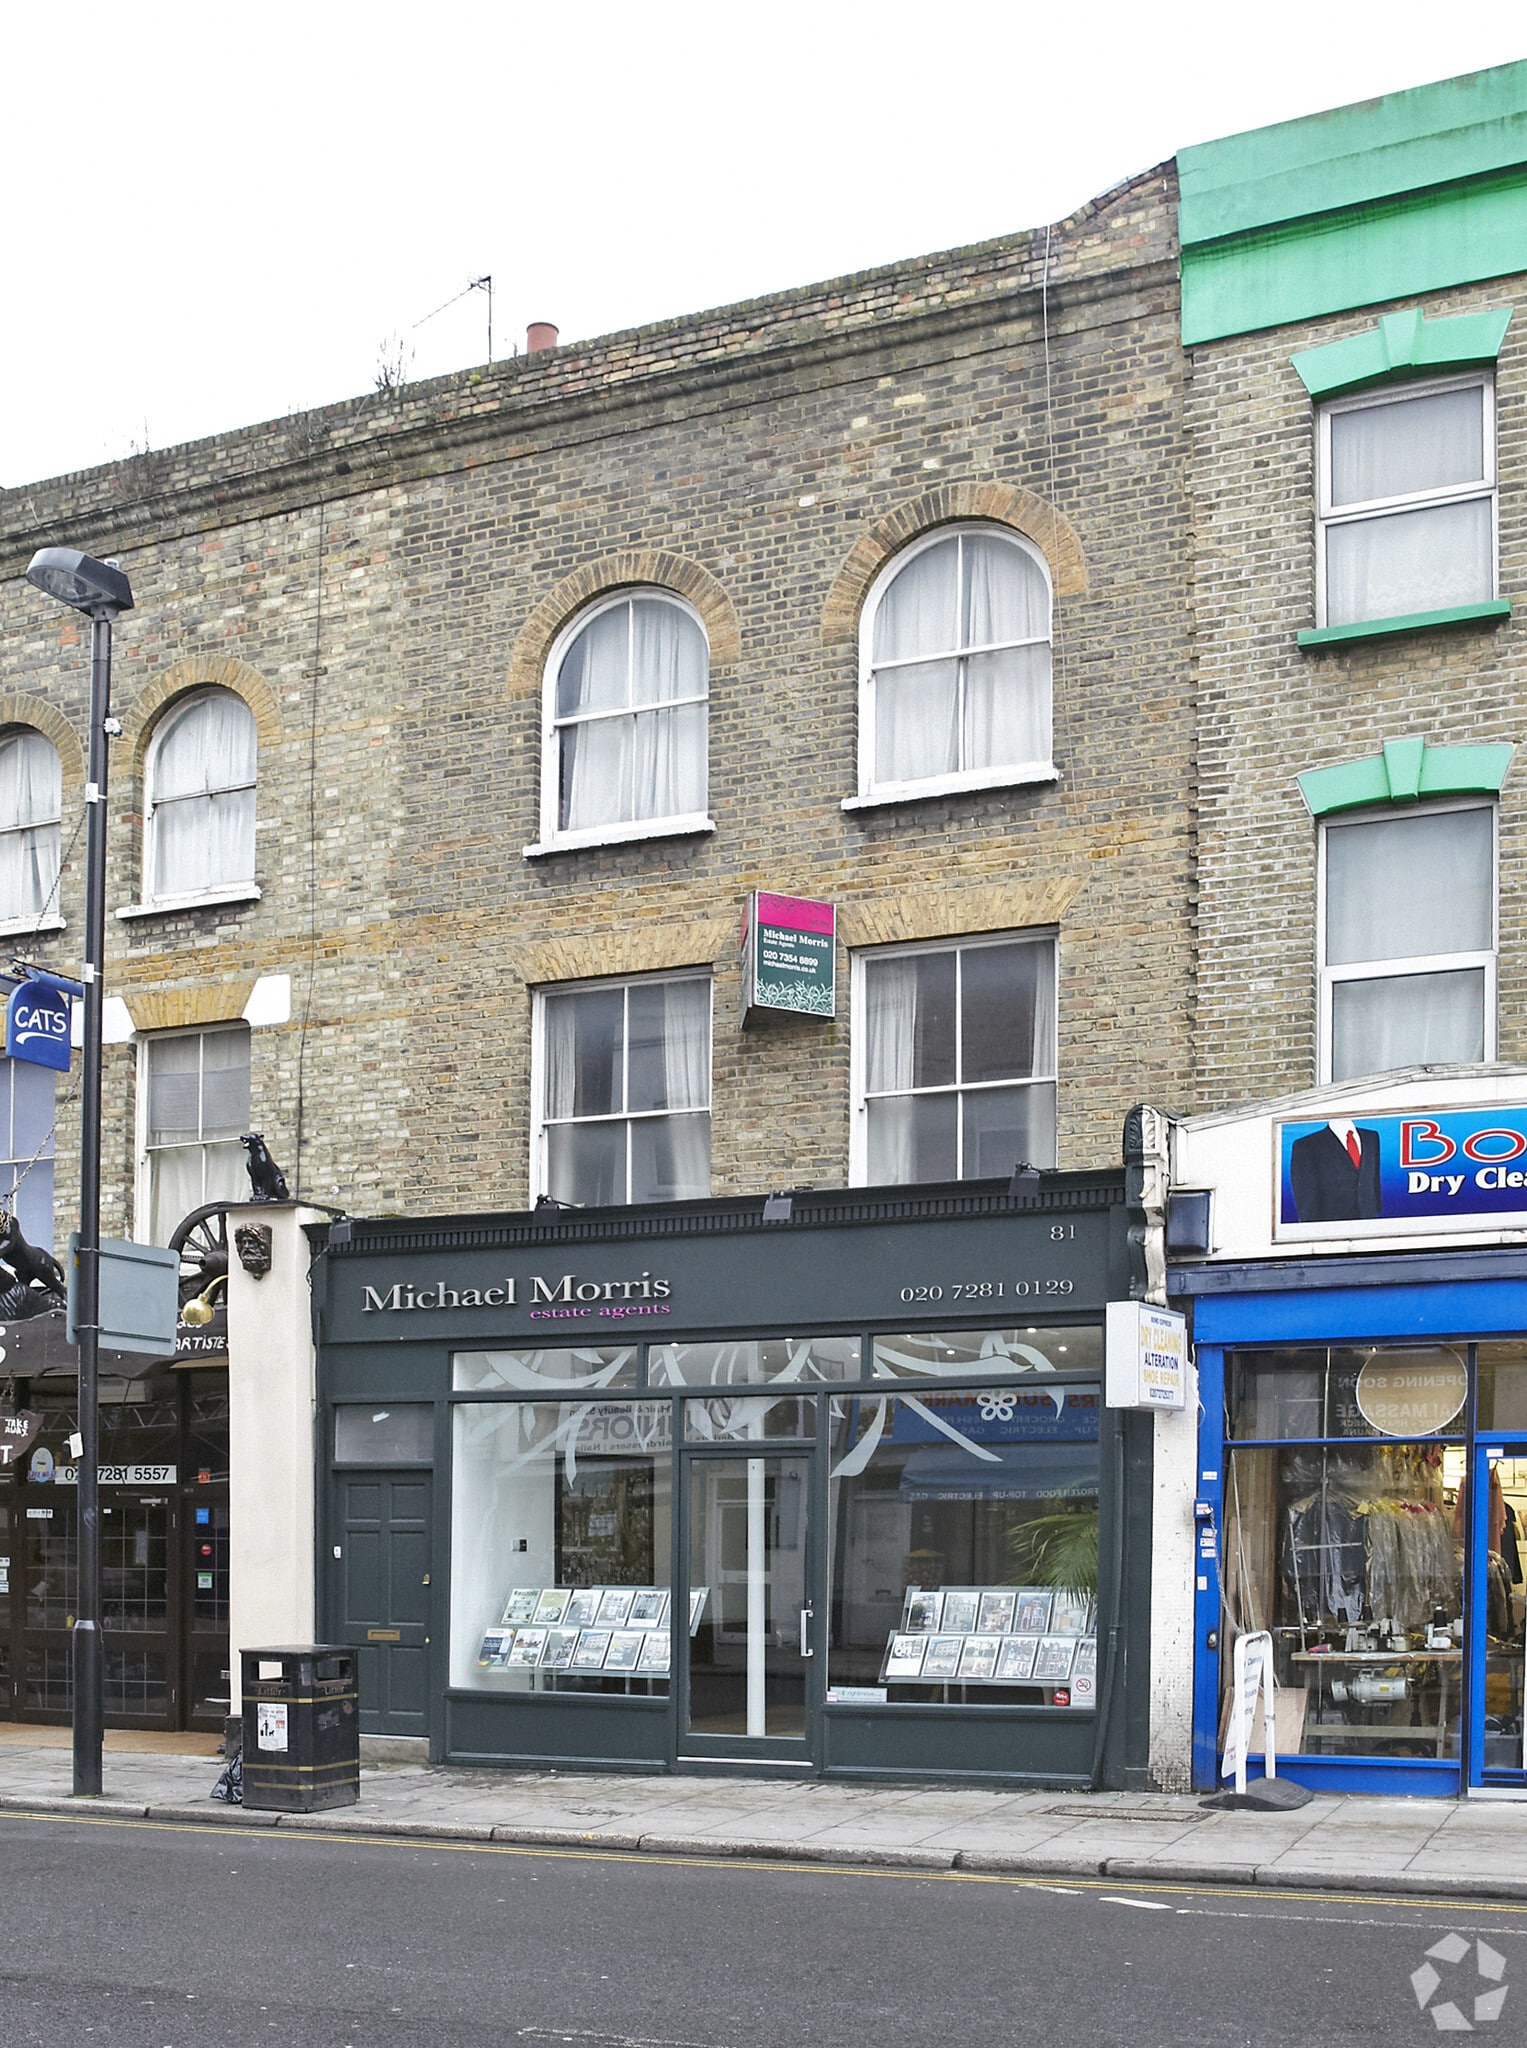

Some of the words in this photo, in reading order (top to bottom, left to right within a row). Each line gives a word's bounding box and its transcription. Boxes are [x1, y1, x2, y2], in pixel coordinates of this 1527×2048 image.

[763, 928, 797, 942] Michael
[799, 935, 829, 948] Morris
[763, 950, 778, 960] 020
[15, 1006, 67, 1034] CATS
[1408, 1171, 1465, 1196] Dry
[1050, 1224, 1075, 1241] 81
[361, 1277, 517, 1312] Michael
[529, 1271, 671, 1303] Morris
[900, 1285, 943, 1302] 020
[952, 1282, 1004, 1299] 7281
[1015, 1279, 1074, 1296] 0129
[530, 1305, 591, 1320] estate
[599, 1303, 671, 1320] agents
[1144, 1351, 1179, 1370] ALTERATION
[5, 1418, 29, 1429] TAKE
[134, 1467, 169, 1480] 5557
